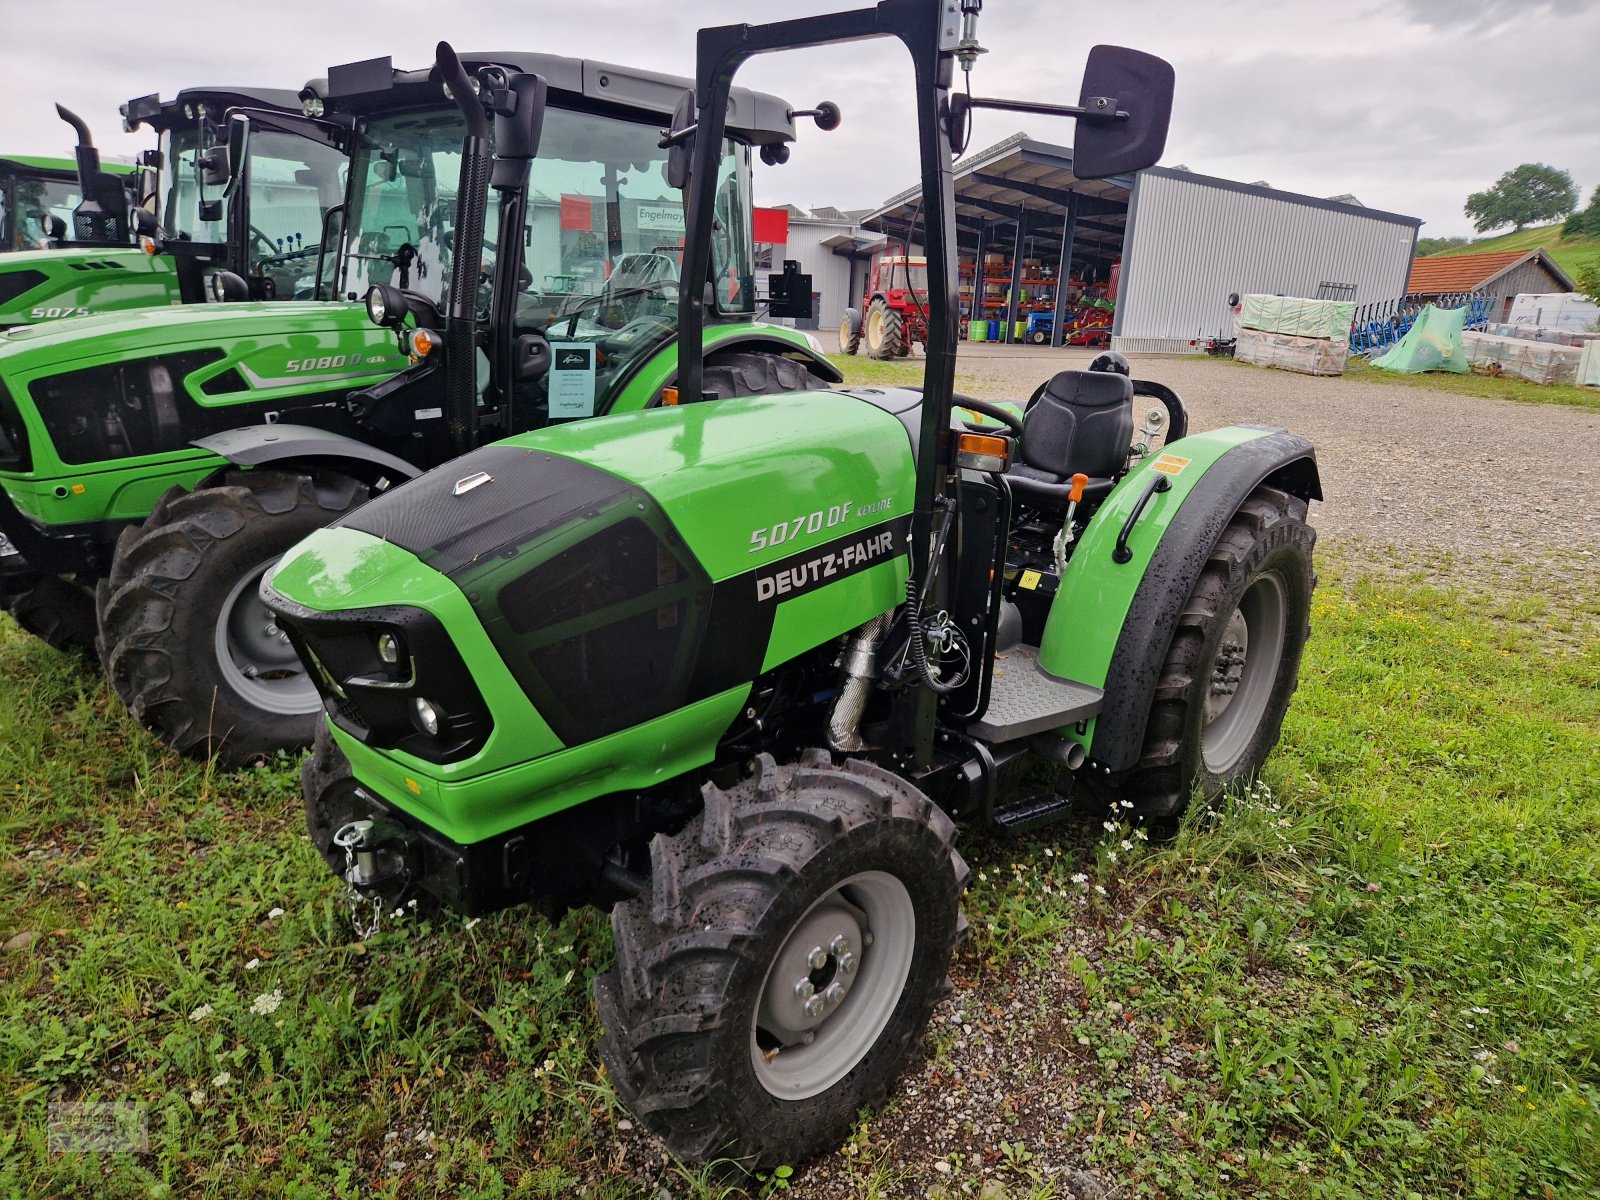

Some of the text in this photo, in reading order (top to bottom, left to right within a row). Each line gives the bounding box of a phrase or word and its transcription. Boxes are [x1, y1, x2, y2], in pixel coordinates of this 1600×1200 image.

[640, 208, 684, 223] Engelmay
[31, 306, 89, 318] 5075
[286, 355, 346, 373] 5080
[350, 353, 362, 366] D
[749, 498, 892, 553] 5070 DF KEYLINE
[756, 531, 894, 602] DEUTZ-FAHR
